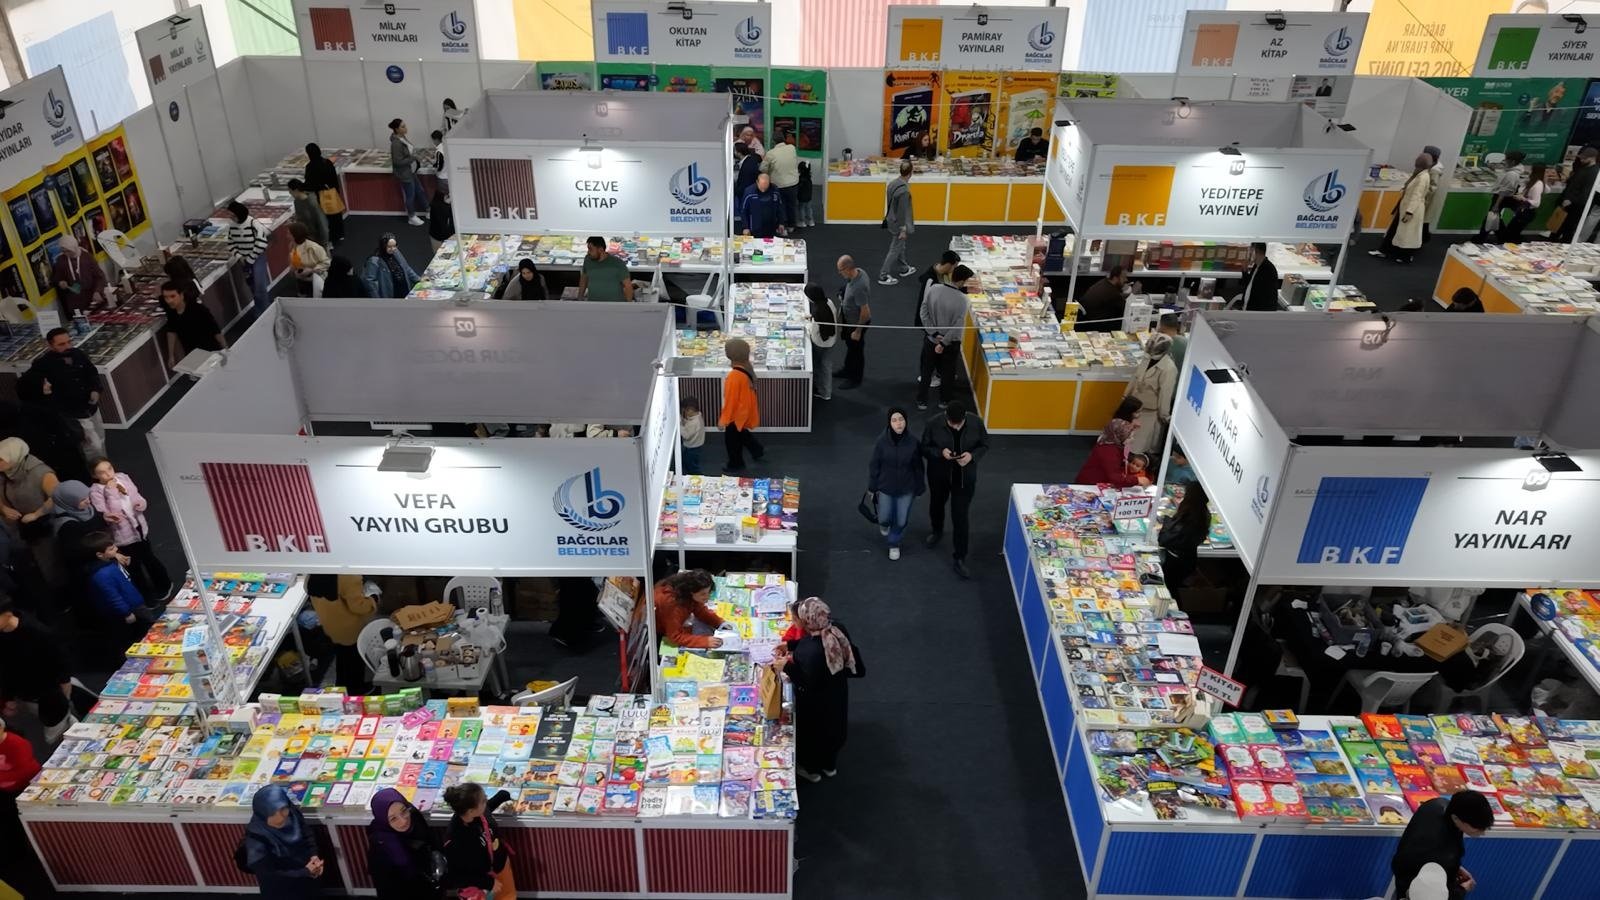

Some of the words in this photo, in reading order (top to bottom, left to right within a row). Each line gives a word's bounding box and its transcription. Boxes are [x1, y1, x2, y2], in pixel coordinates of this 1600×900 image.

[379, 21, 407, 31] MİLAY
[669, 26, 707, 36] OKUTAN
[371, 33, 418, 43] YAYINLARI
[675, 38, 702, 48] KİTAP
[961, 32, 1003, 41] PAMİRAY
[1270, 38, 1283, 46] AZ
[958, 44, 1005, 53] YAYINLARI
[1562, 40, 1587, 49] SİYER
[1261, 49, 1288, 59] KİTAP
[1548, 52, 1594, 61] YAYINLARI
[0, 122, 24, 142] YİDAR
[0, 136, 33, 162] AYINLARI
[575, 179, 619, 193] CEZVE
[1201, 187, 1264, 201] YEDİTEPE
[579, 195, 617, 209] KİTAP
[1199, 203, 1258, 217] YAYINEVİ
[1296, 213, 1339, 222] BAĞCILAR
[1221, 409, 1239, 442] NAR
[1207, 416, 1244, 484] YAYINLARI
[394, 493, 456, 509] VEFA
[1124, 499, 1149, 507] KİTAP
[350, 516, 419, 533] YAYIN
[424, 517, 509, 534] GRUBU
[1495, 510, 1547, 526] NAR
[244, 534, 326, 552] BKF
[556, 534, 629, 546] BAĞCILAR
[1453, 533, 1572, 550] YAYINLARI
[557, 547, 630, 556] BELEDİYESİ
[1319, 546, 1401, 565] BKF
[1211, 675, 1241, 692] KİTAP
[1203, 682, 1219, 693] 100
[1223, 692, 1233, 701] TL
